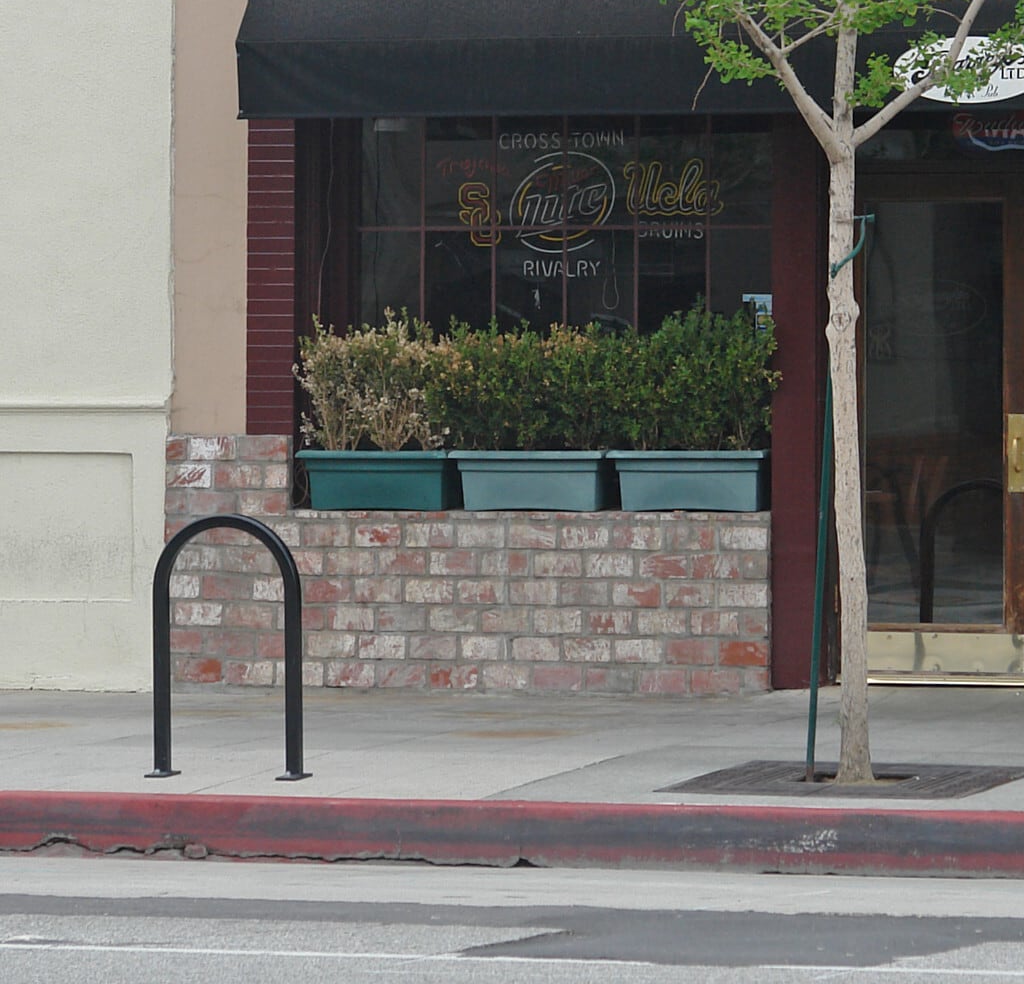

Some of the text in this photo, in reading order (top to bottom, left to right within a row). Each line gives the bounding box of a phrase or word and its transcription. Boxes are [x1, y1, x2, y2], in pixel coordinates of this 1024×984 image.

[499, 129, 624, 150] CROSS TOWN
[523, 260, 601, 278] RIVALRY
